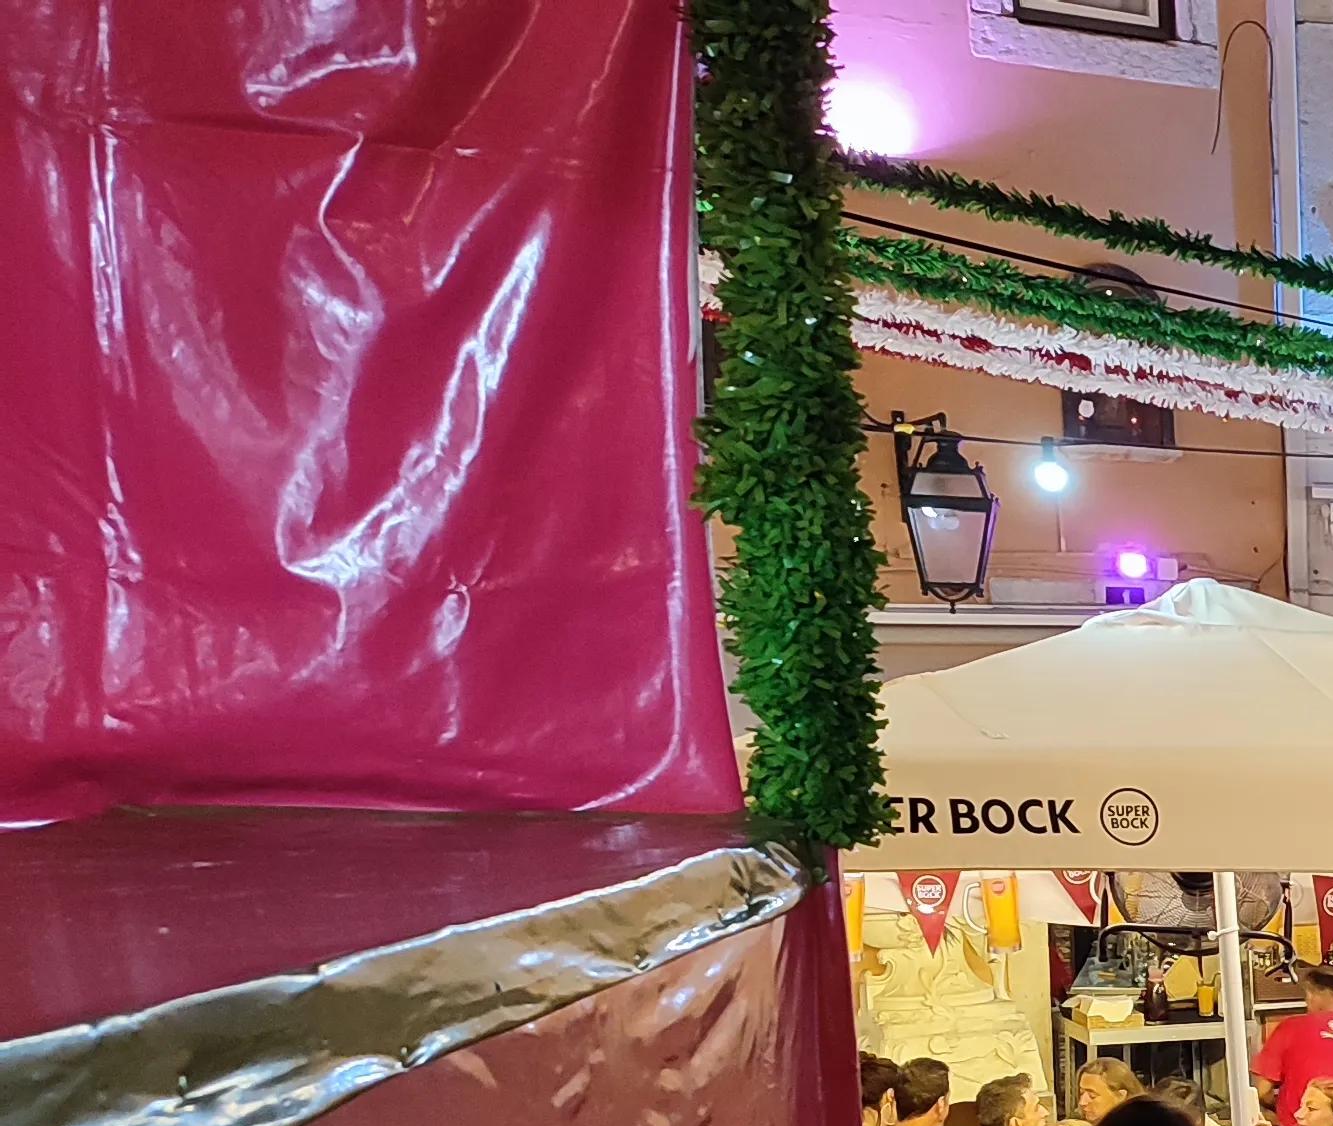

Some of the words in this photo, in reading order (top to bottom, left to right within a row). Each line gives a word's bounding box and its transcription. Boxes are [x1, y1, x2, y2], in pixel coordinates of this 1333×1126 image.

[949, 798, 1081, 834] BOCK
[1107, 804, 1150, 817] SUPER
[1111, 817, 1149, 829] BOCK
